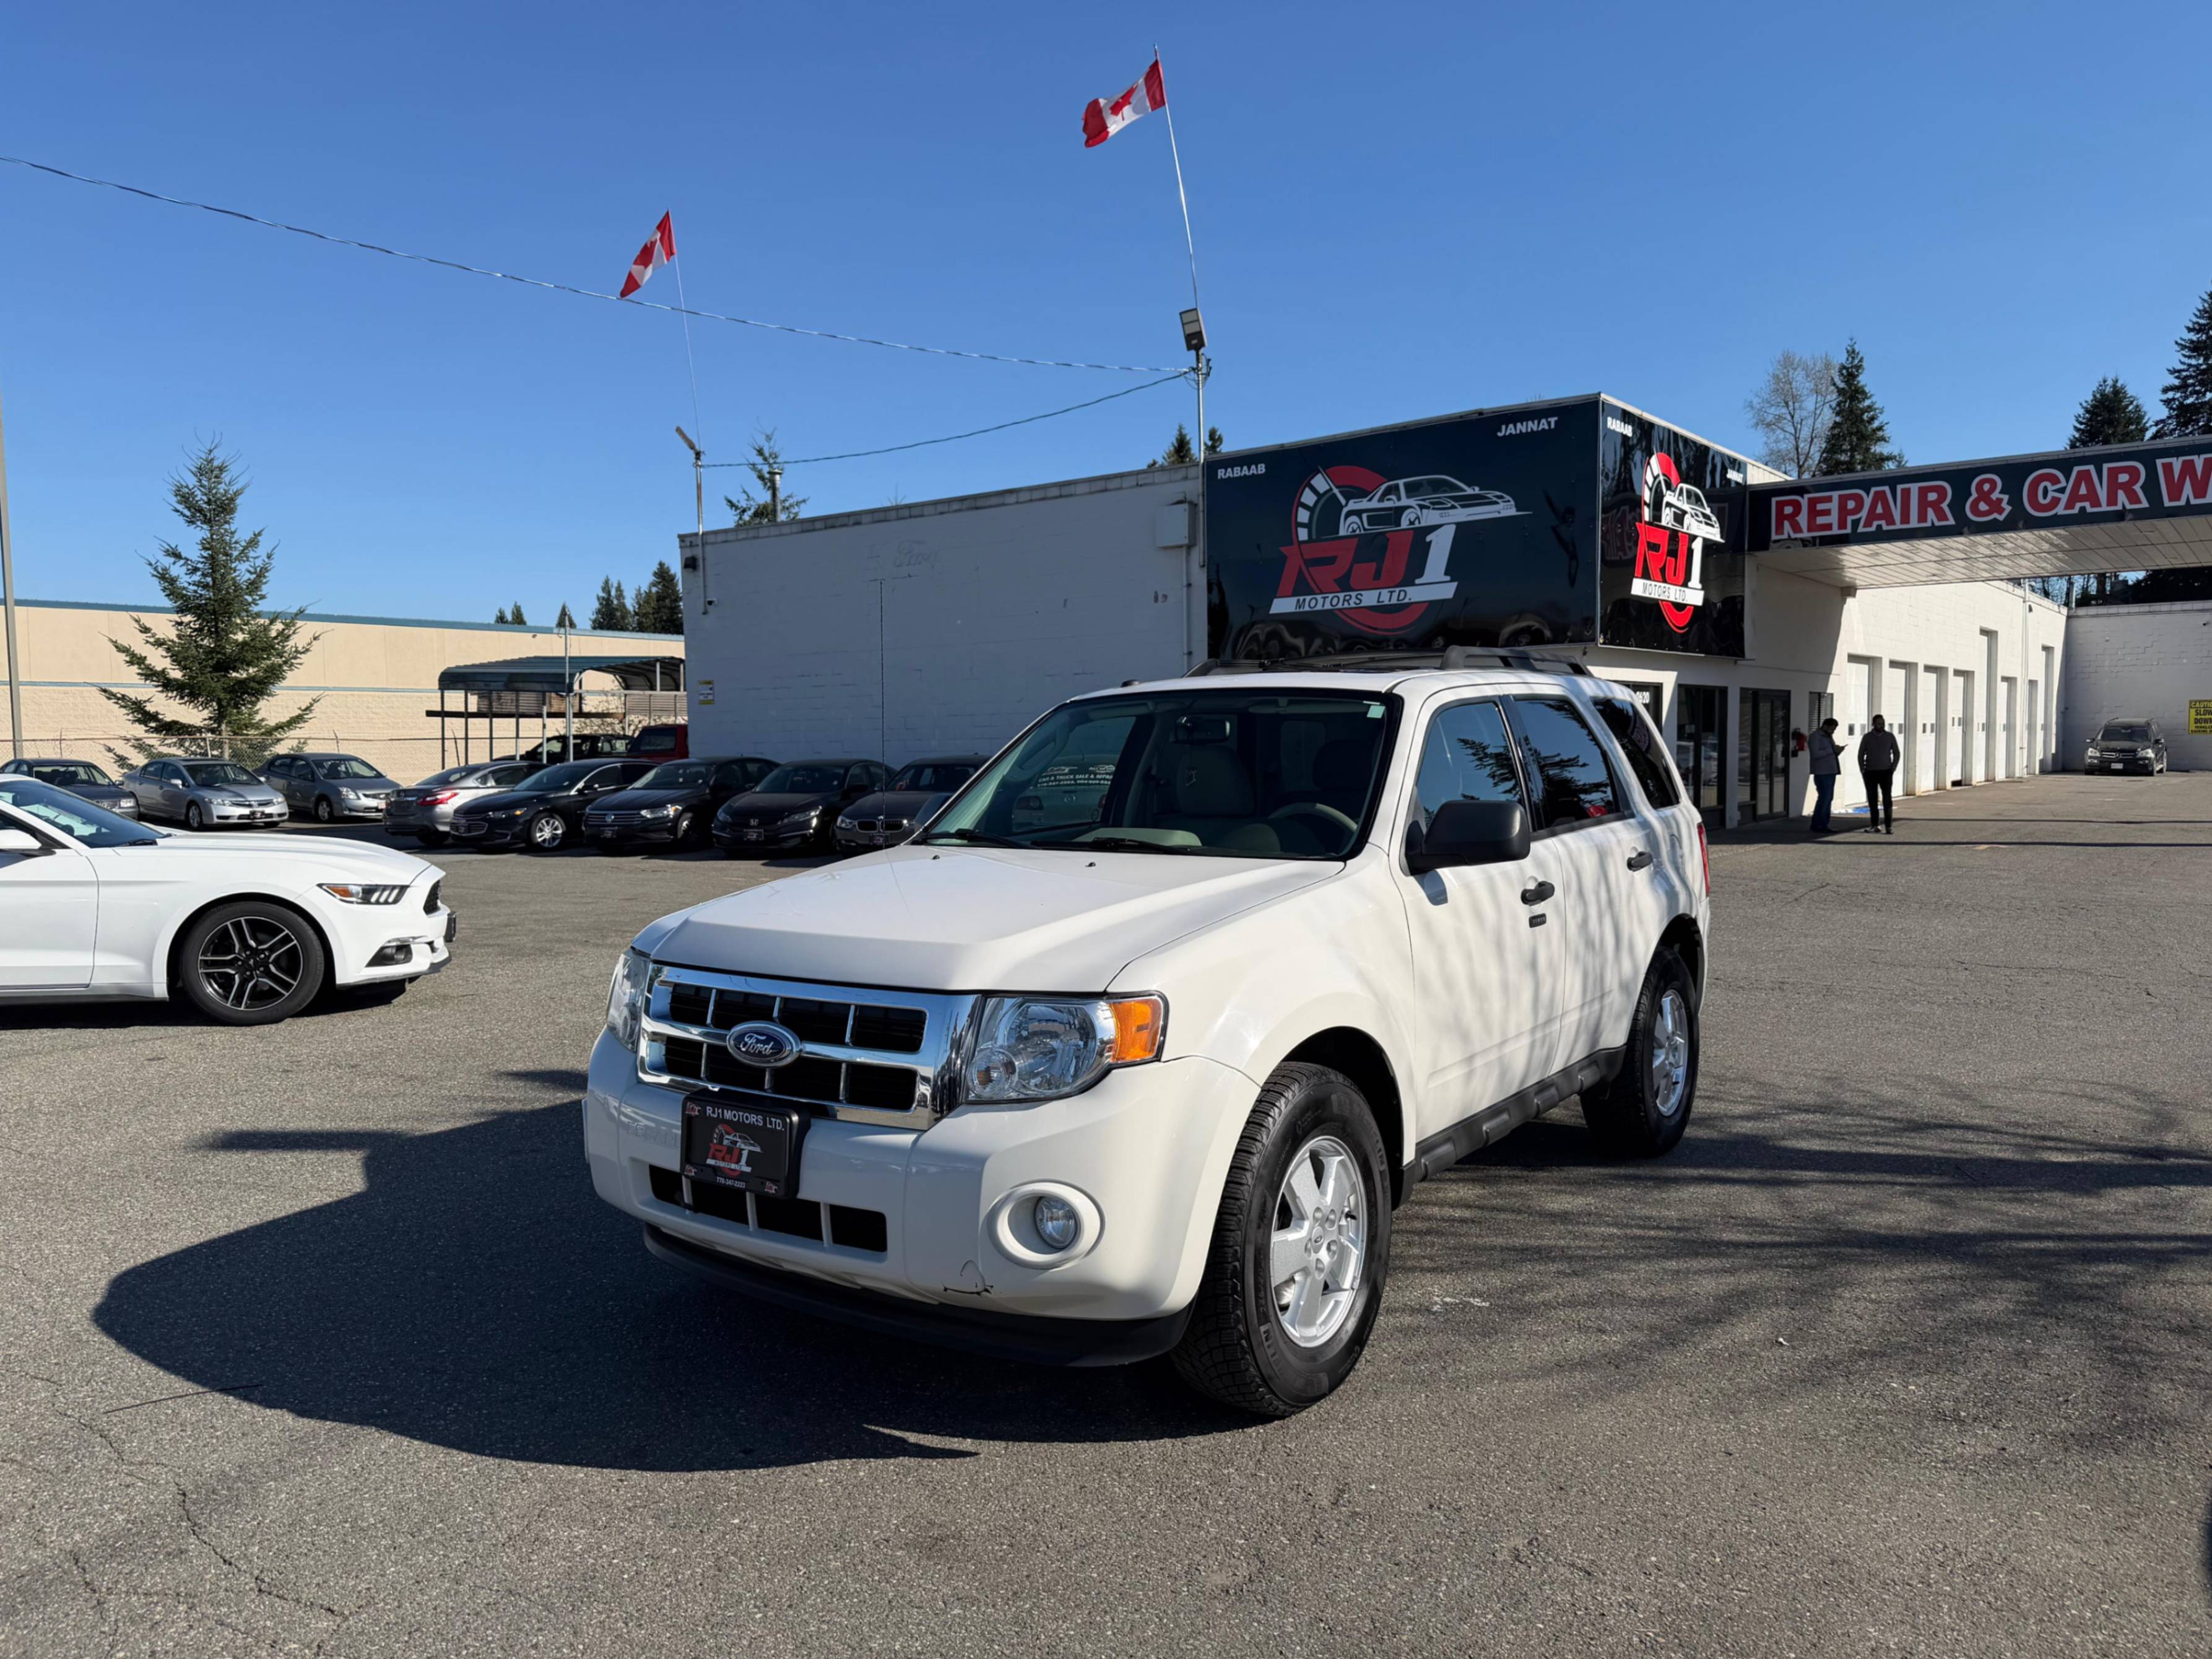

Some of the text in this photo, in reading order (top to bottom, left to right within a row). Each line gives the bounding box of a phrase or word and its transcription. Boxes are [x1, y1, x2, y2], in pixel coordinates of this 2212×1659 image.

[1497, 417, 1558, 437] JANNAT
[1607, 417, 1633, 437] RABAAB
[1218, 463, 1266, 479] RABAAB
[1771, 480, 1956, 541] REPAIR
[1965, 474, 2011, 521] &
[2023, 461, 2149, 515] CAR
[1277, 524, 1456, 598] RJ1
[1634, 522, 1702, 590] RJ1
[1295, 590, 1412, 611] MOTORS LTD.
[1642, 582, 1671, 599] MOTORS
[740, 1033, 774, 1055] Ford
[724, 1109, 763, 1126] MOTORS
[766, 1117, 784, 1131] LTD.
[708, 1143, 748, 1167] RJ1
